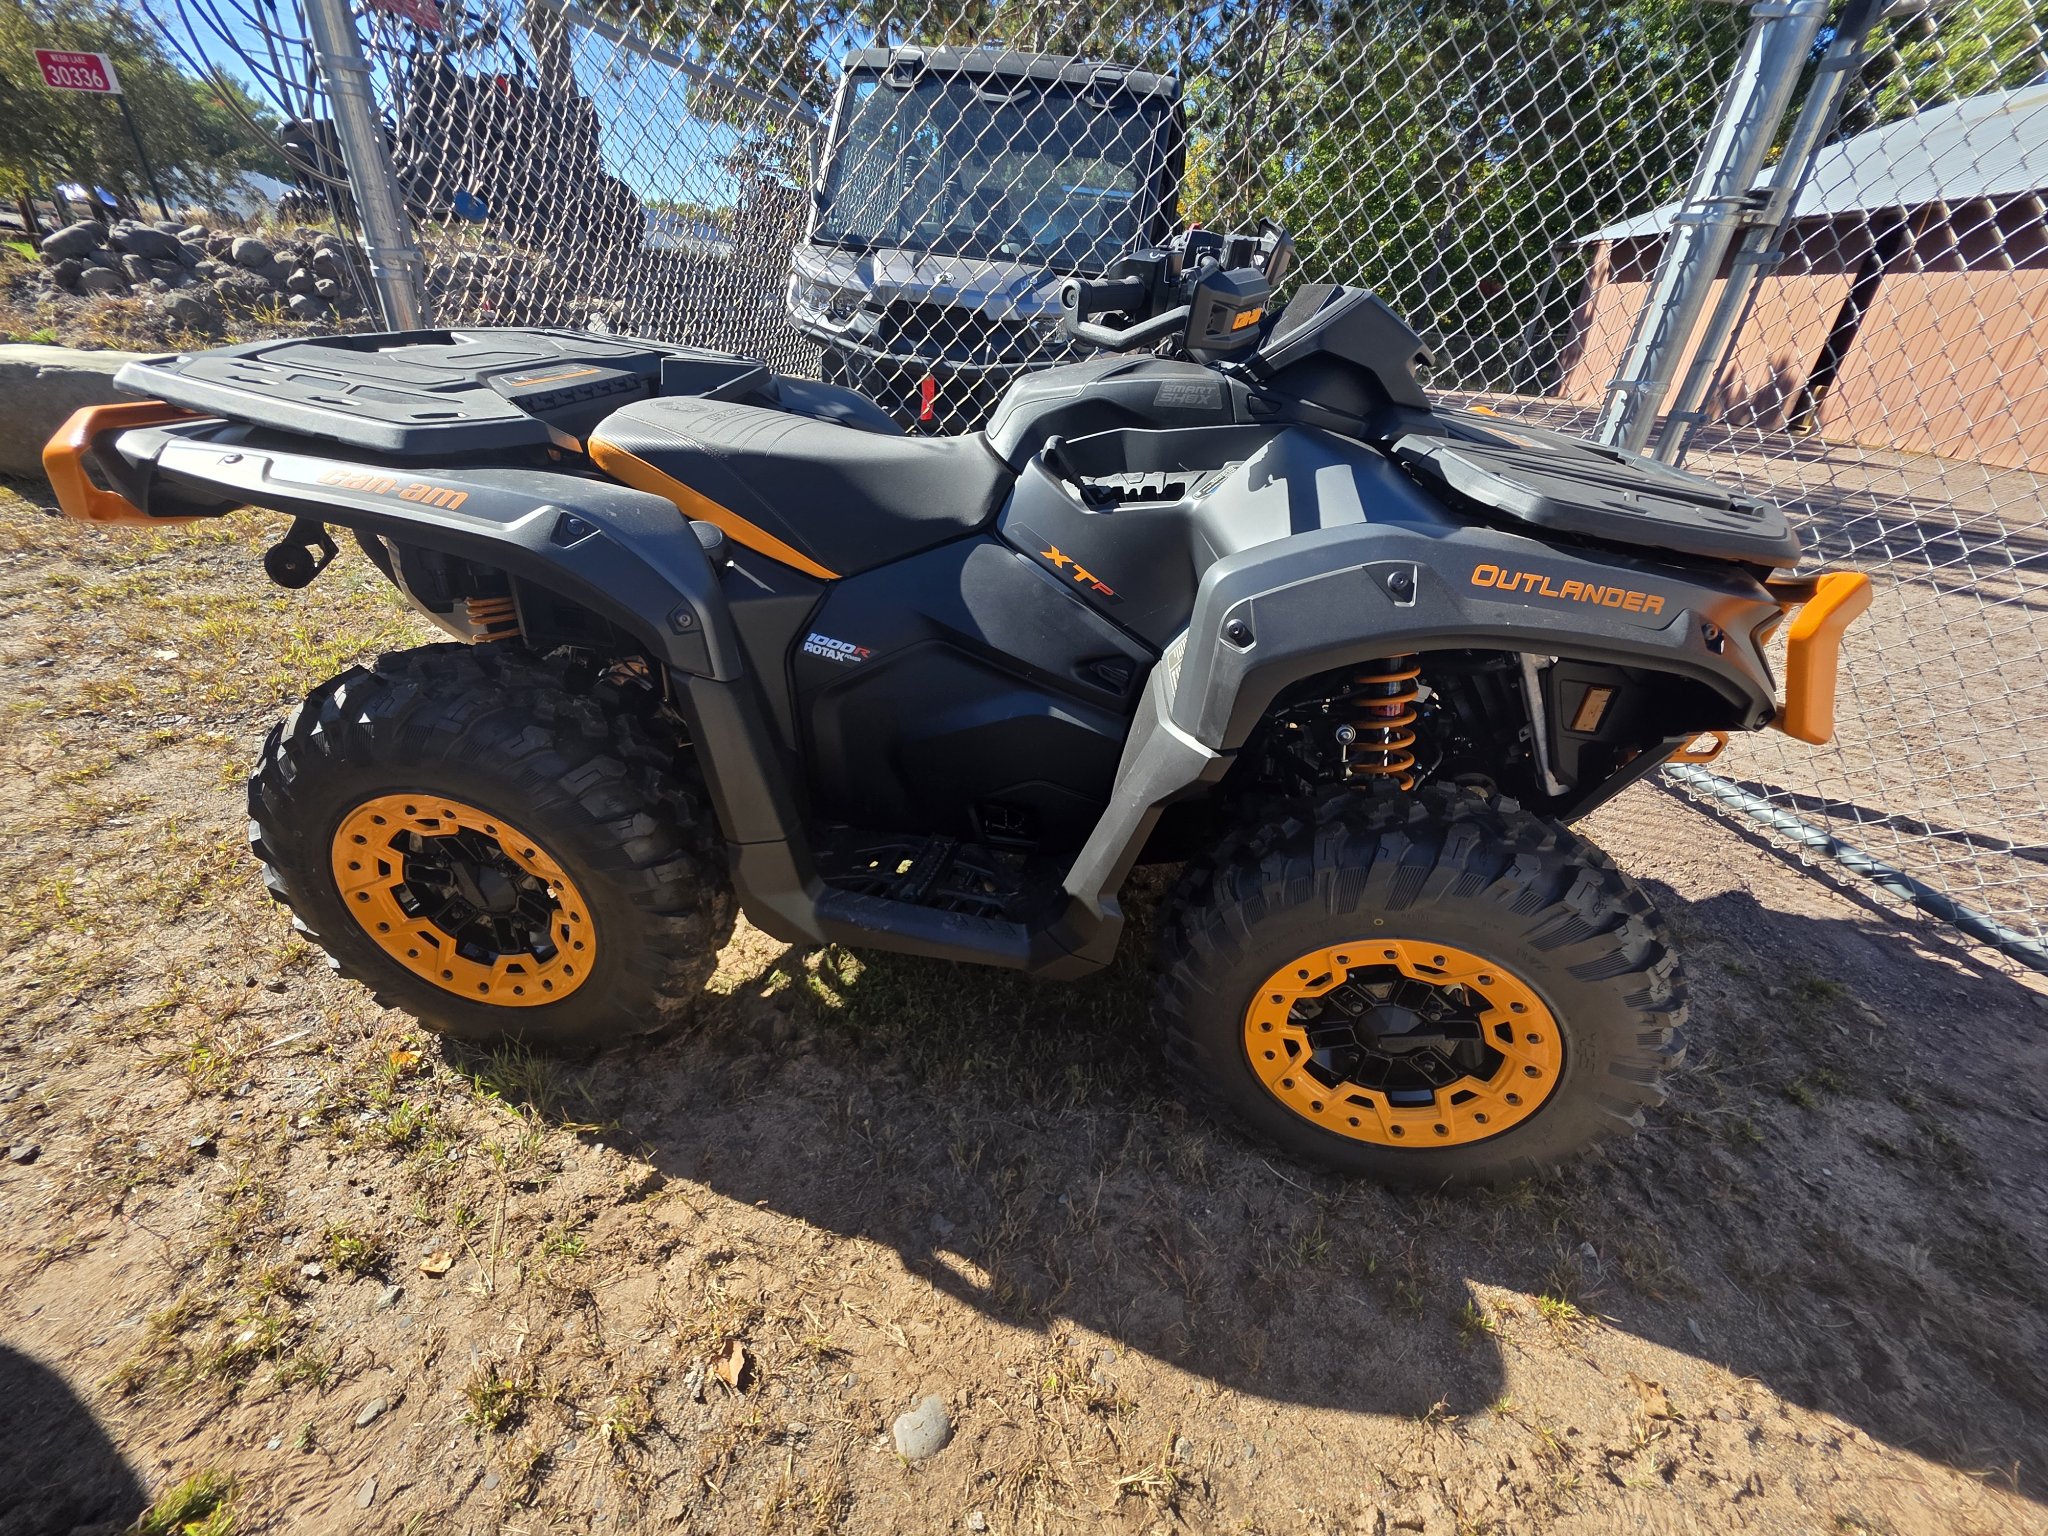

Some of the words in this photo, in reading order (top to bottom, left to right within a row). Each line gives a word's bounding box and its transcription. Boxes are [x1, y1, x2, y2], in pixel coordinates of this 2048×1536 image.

[69, 56, 88, 65] LAKE
[47, 64, 104, 88] 30336
[1160, 393, 1211, 405] SHOX
[1162, 384, 1217, 395] SMART
[316, 469, 469, 511] can-am
[1040, 545, 1115, 596] XTP
[1471, 564, 1665, 615] OUTLANDER
[803, 642, 844, 662] ROTAX
